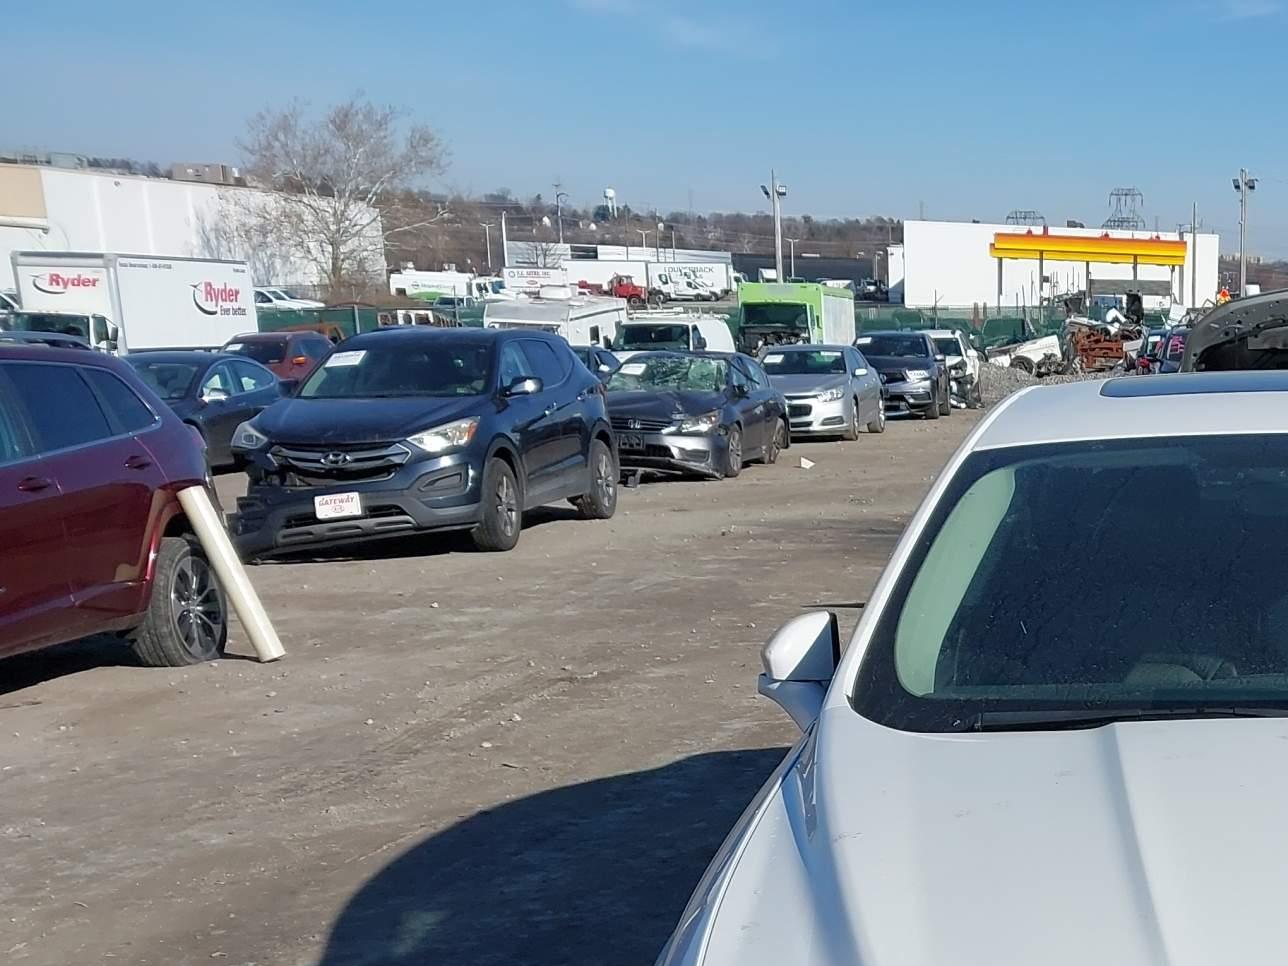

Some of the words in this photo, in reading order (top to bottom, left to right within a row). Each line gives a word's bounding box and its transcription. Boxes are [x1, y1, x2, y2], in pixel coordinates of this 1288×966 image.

[49, 273, 99, 290] Ryder
[203, 281, 240, 307] Ryder
[220, 305, 231, 315] Ever
